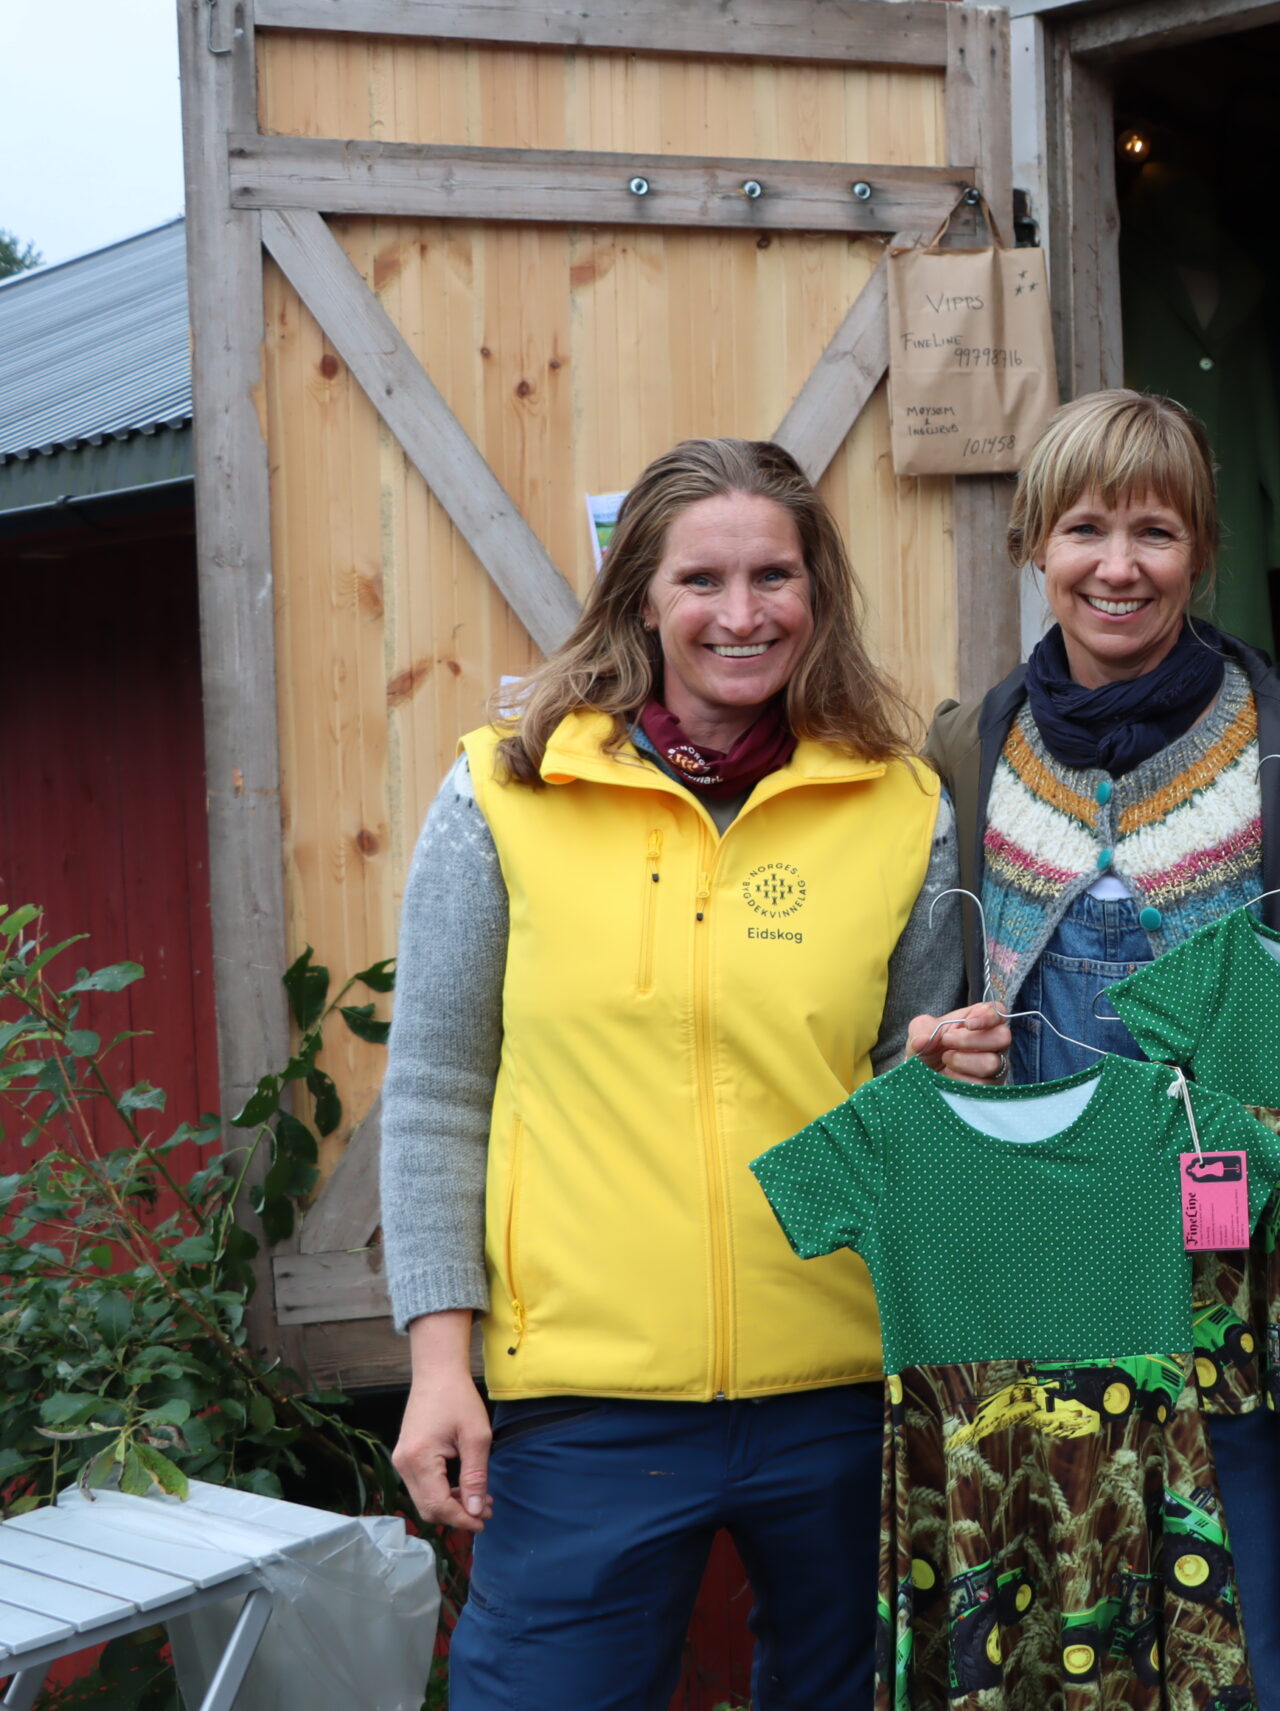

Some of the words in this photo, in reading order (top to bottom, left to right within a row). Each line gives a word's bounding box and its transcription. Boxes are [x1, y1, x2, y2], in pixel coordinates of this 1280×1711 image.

[925, 293, 985, 313] VIPPS
[954, 347, 1023, 368] 99798716
[963, 434, 1017, 457] 101458
[749, 862, 799, 878] NORGES
[742, 879, 807, 919] BYGDEKVINNELAG
[747, 927, 803, 944] Eidskog
[1186, 1192, 1198, 1246] FineLine
